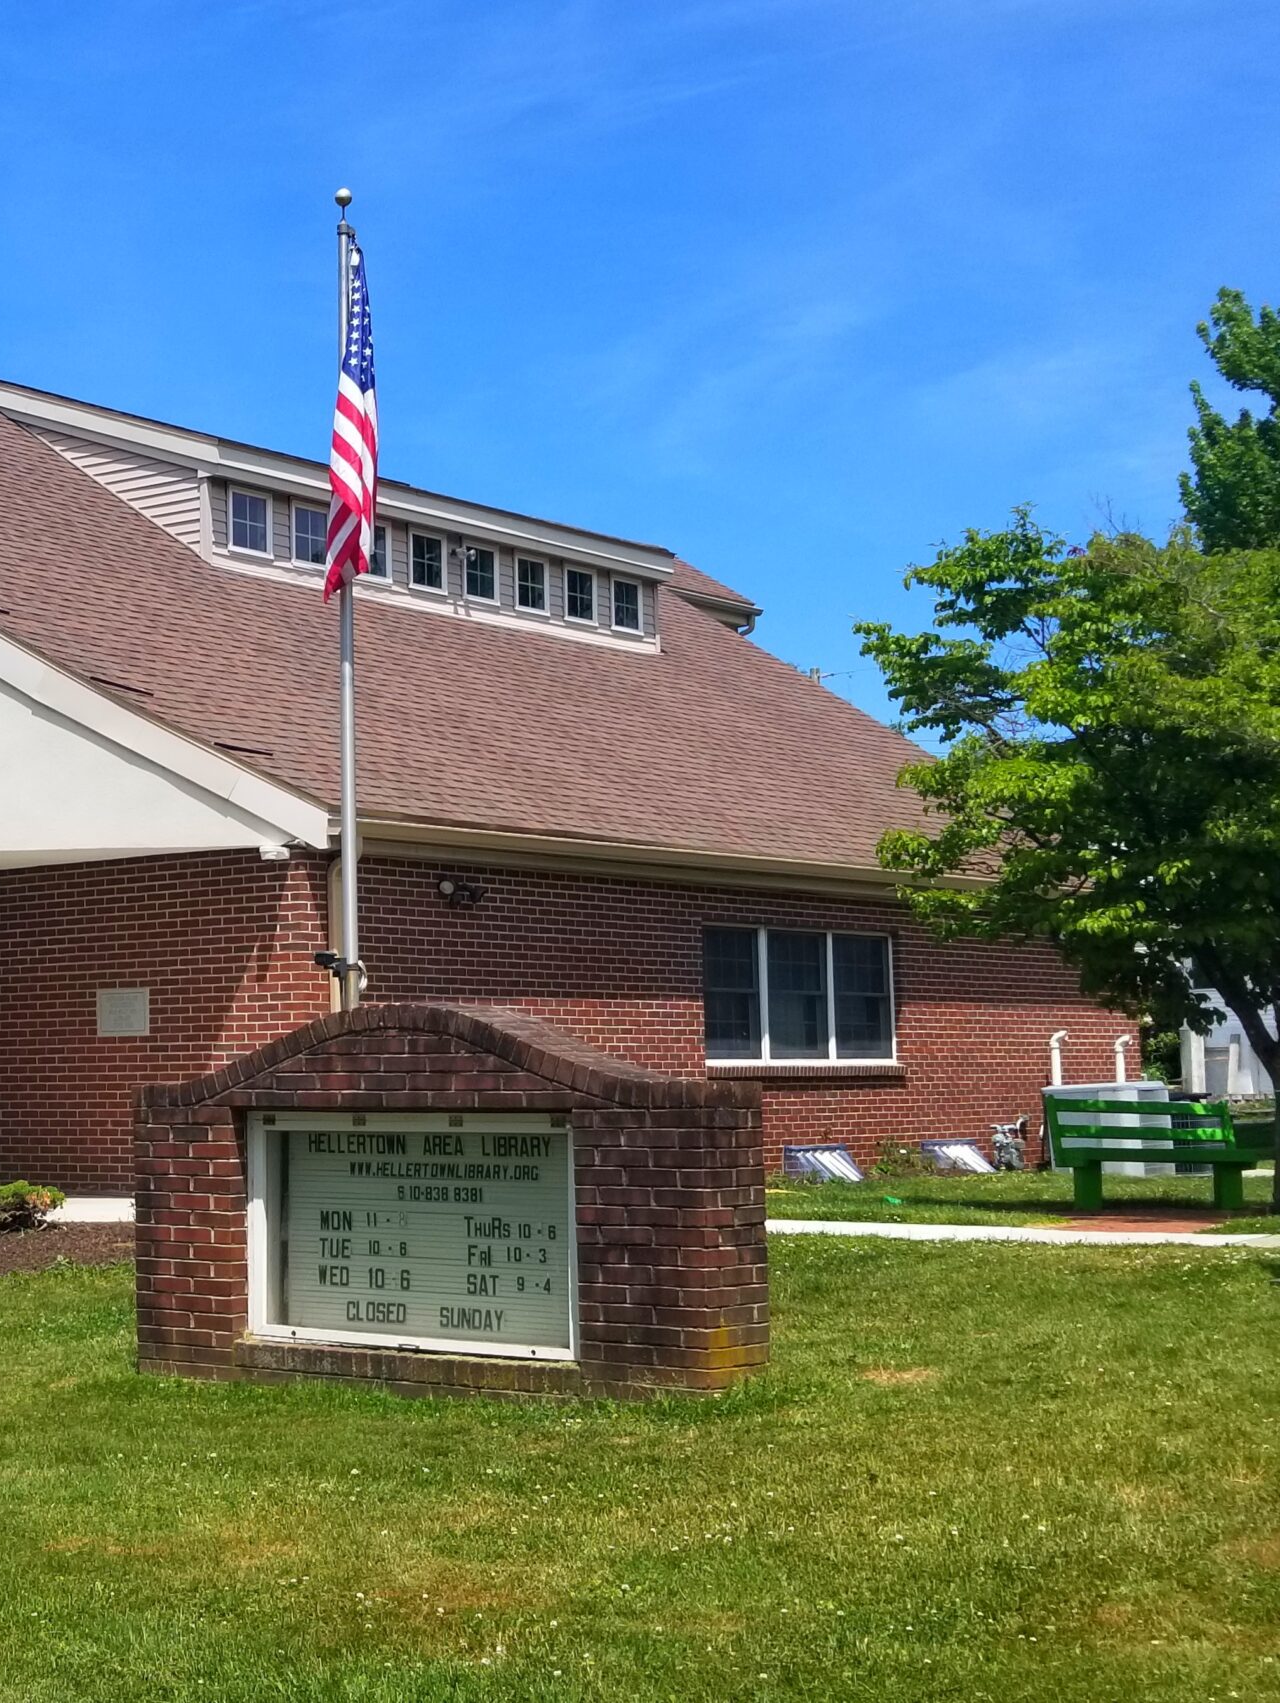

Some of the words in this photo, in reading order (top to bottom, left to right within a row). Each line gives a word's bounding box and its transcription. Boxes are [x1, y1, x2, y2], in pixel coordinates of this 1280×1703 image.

[308, 1133, 406, 1155] HELLERTOWN
[423, 1135, 464, 1156] AREA
[482, 1135, 552, 1158] LIBRARY
[349, 1162, 539, 1181] WWW.HELLERTOWNLIBRARY.ORG
[454, 1187, 483, 1203] 8381
[320, 1210, 352, 1231] MON
[366, 1212, 377, 1227] 11
[518, 1223, 531, 1239] 10
[548, 1225, 557, 1240] 6
[319, 1238, 351, 1259] TUE
[368, 1240, 380, 1255] 10
[400, 1242, 408, 1256] 6
[506, 1246, 522, 1262] 10
[539, 1248, 547, 1263] 3
[318, 1264, 350, 1286] WED
[368, 1267, 385, 1288] 10
[400, 1269, 411, 1290] 6
[467, 1273, 499, 1296] SAT
[516, 1276, 525, 1291] 9
[543, 1278, 552, 1295] 4
[346, 1300, 407, 1324] CLOSED
[440, 1306, 504, 1332] SUNDAY
